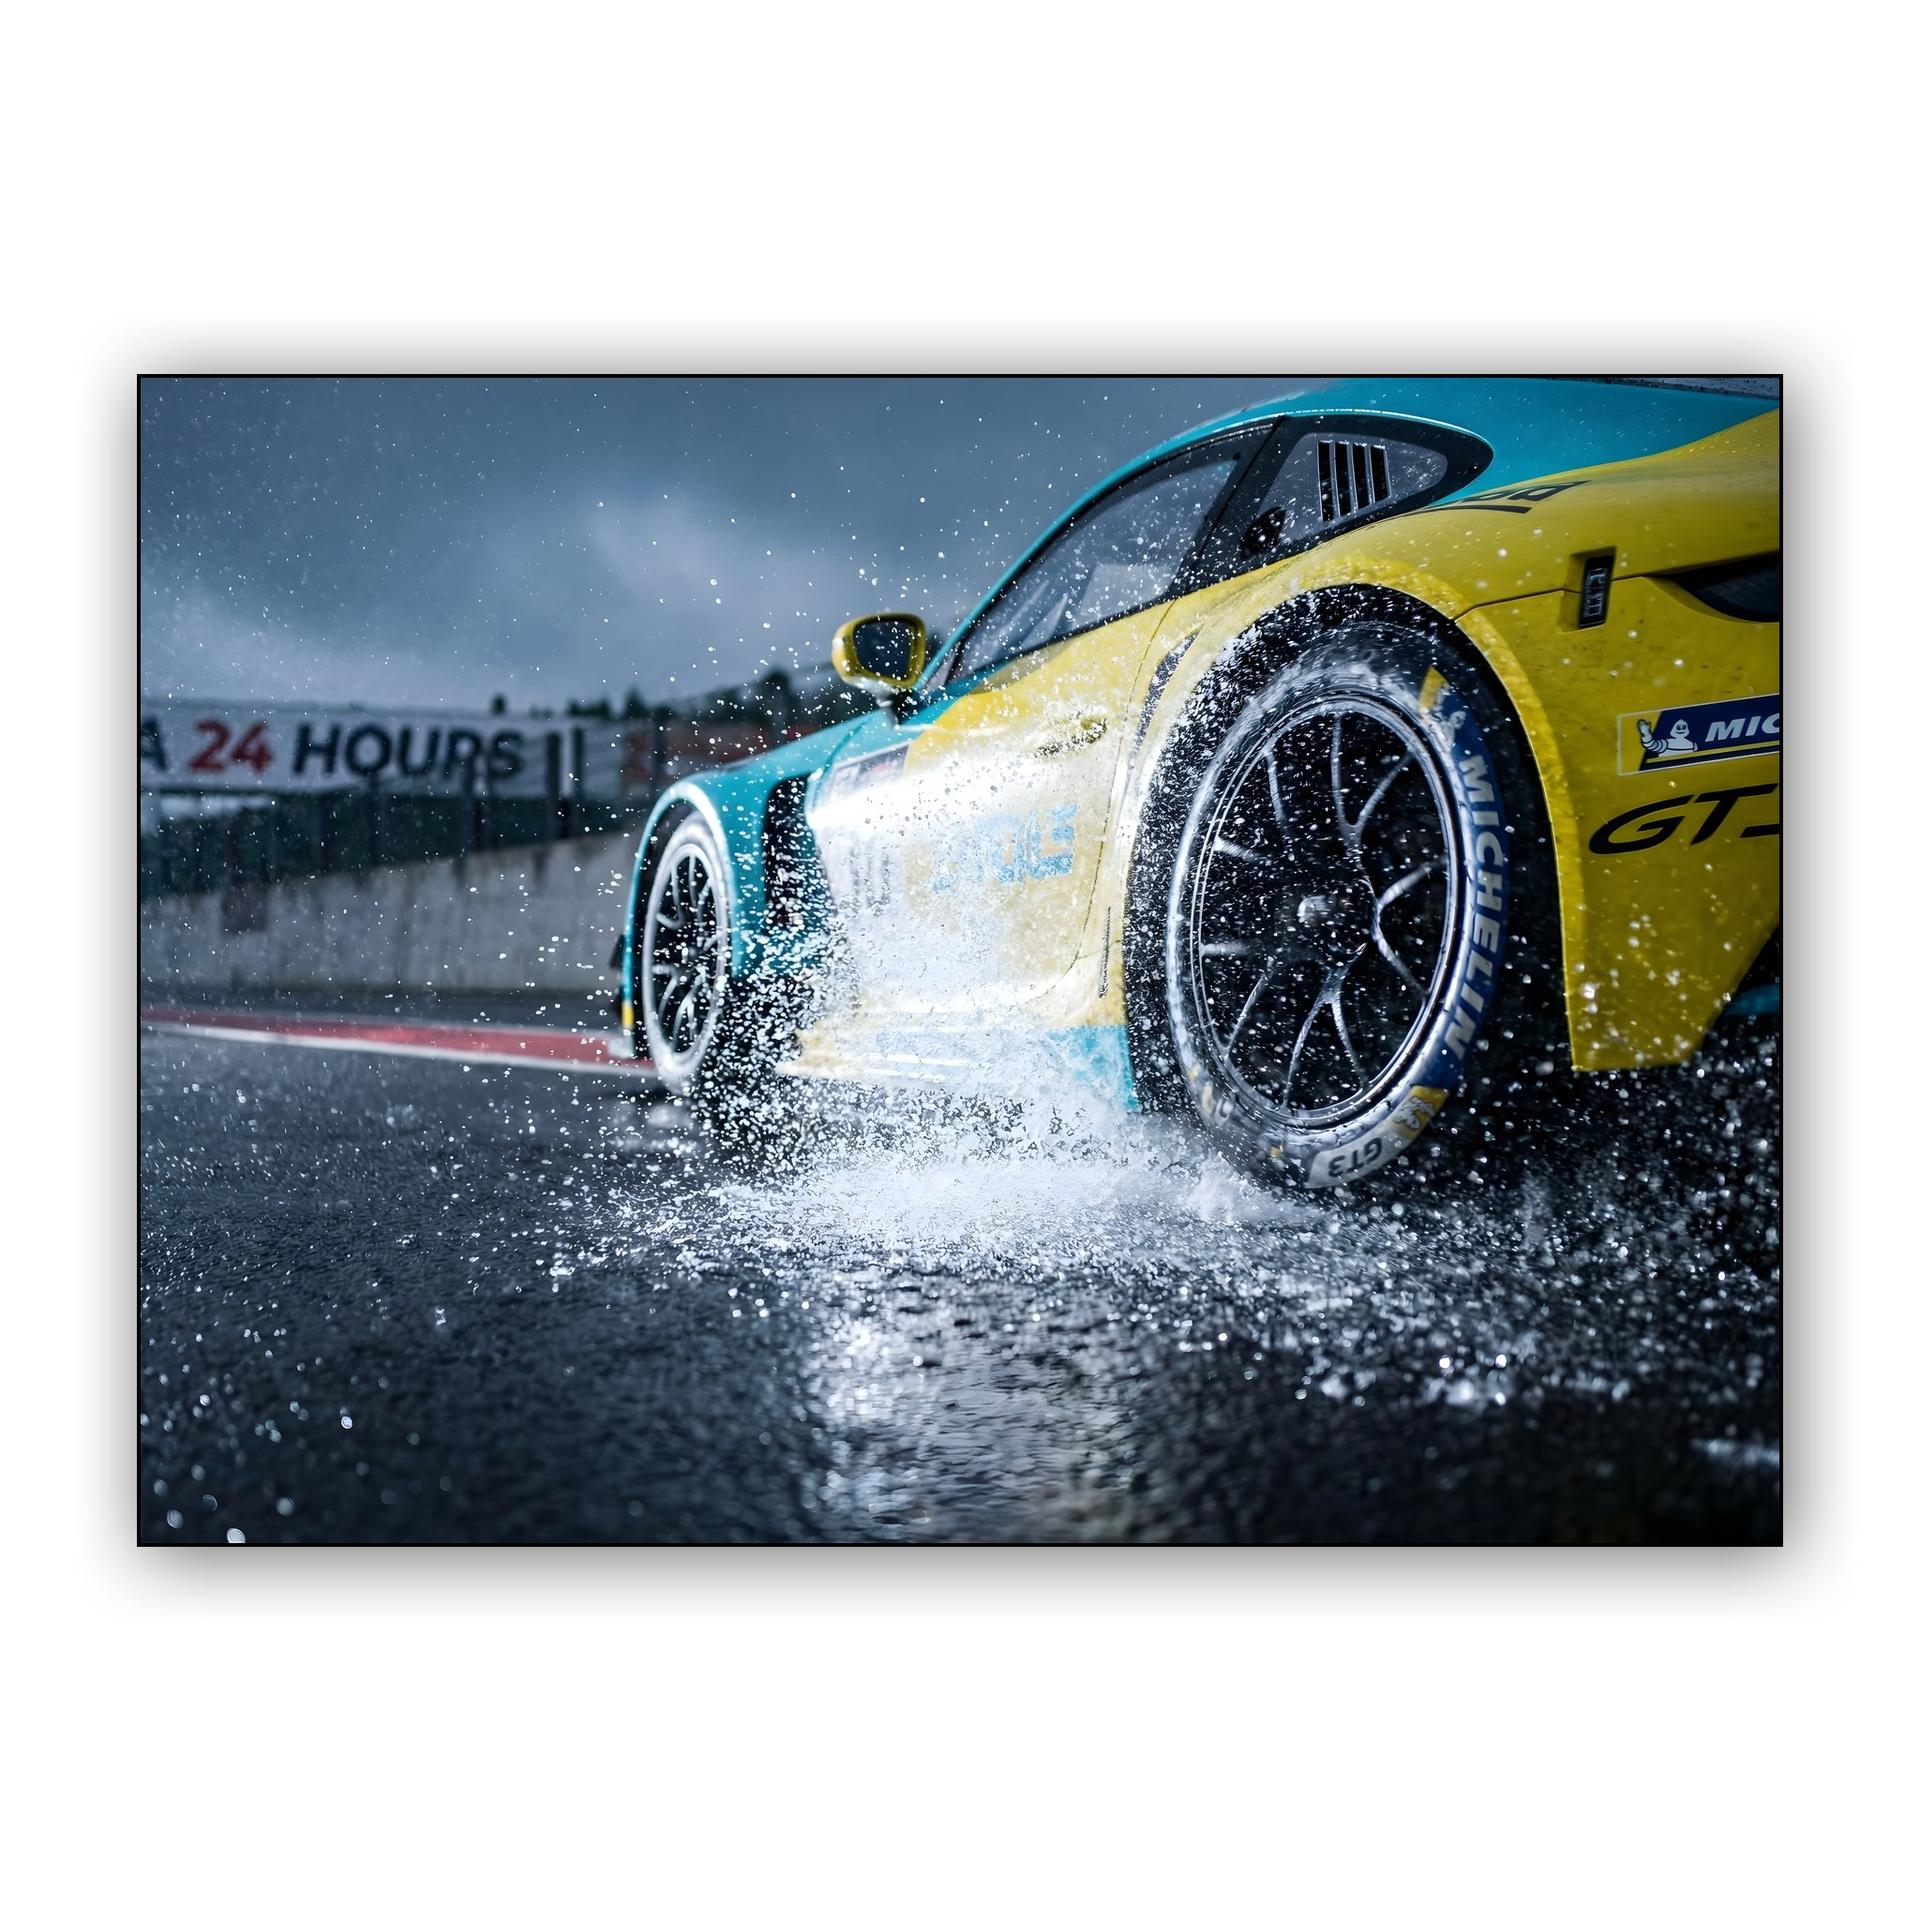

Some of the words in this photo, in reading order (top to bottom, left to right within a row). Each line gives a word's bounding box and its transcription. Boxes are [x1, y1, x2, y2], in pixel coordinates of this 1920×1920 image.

[188, 720, 272, 774] 24
[292, 720, 526, 778] HOURS
[1444, 754, 1504, 1060] MICHELIN
[1328, 1138, 1382, 1177] GT3
